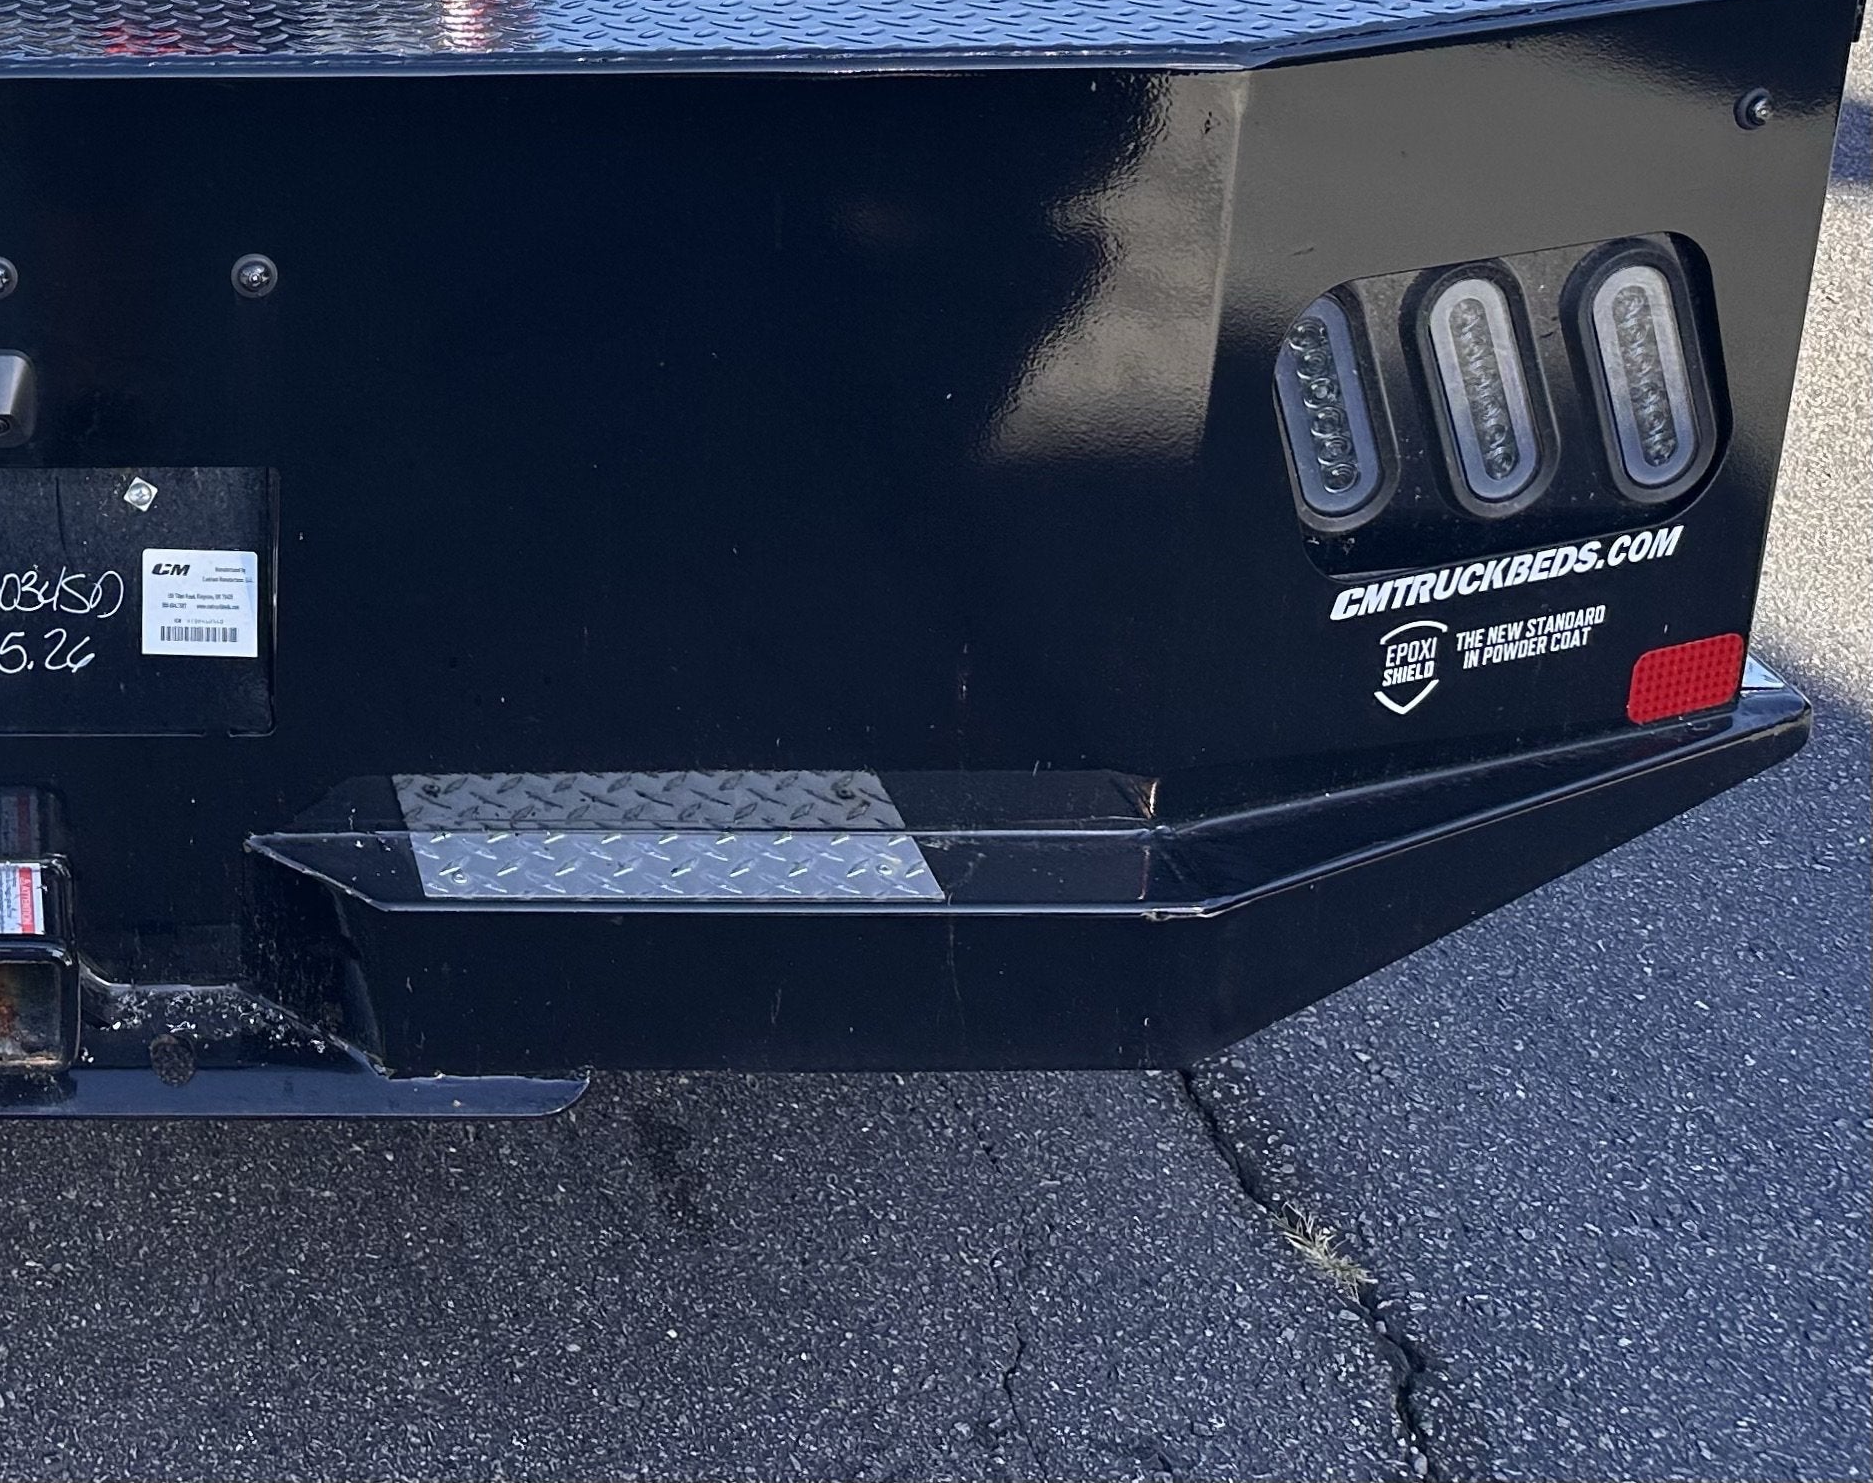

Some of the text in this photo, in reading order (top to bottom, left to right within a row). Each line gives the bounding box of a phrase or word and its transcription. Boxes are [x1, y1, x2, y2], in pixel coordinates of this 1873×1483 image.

[1329, 524, 1685, 621] CMTRUCKBEDS.COM
[1456, 605, 1606, 651] THE NEW STANDARD
[1462, 626, 1592, 669] IN POWDER COAT
[1382, 660, 1435, 687] SHIELD
[1385, 637, 1438, 668] EPOXI
